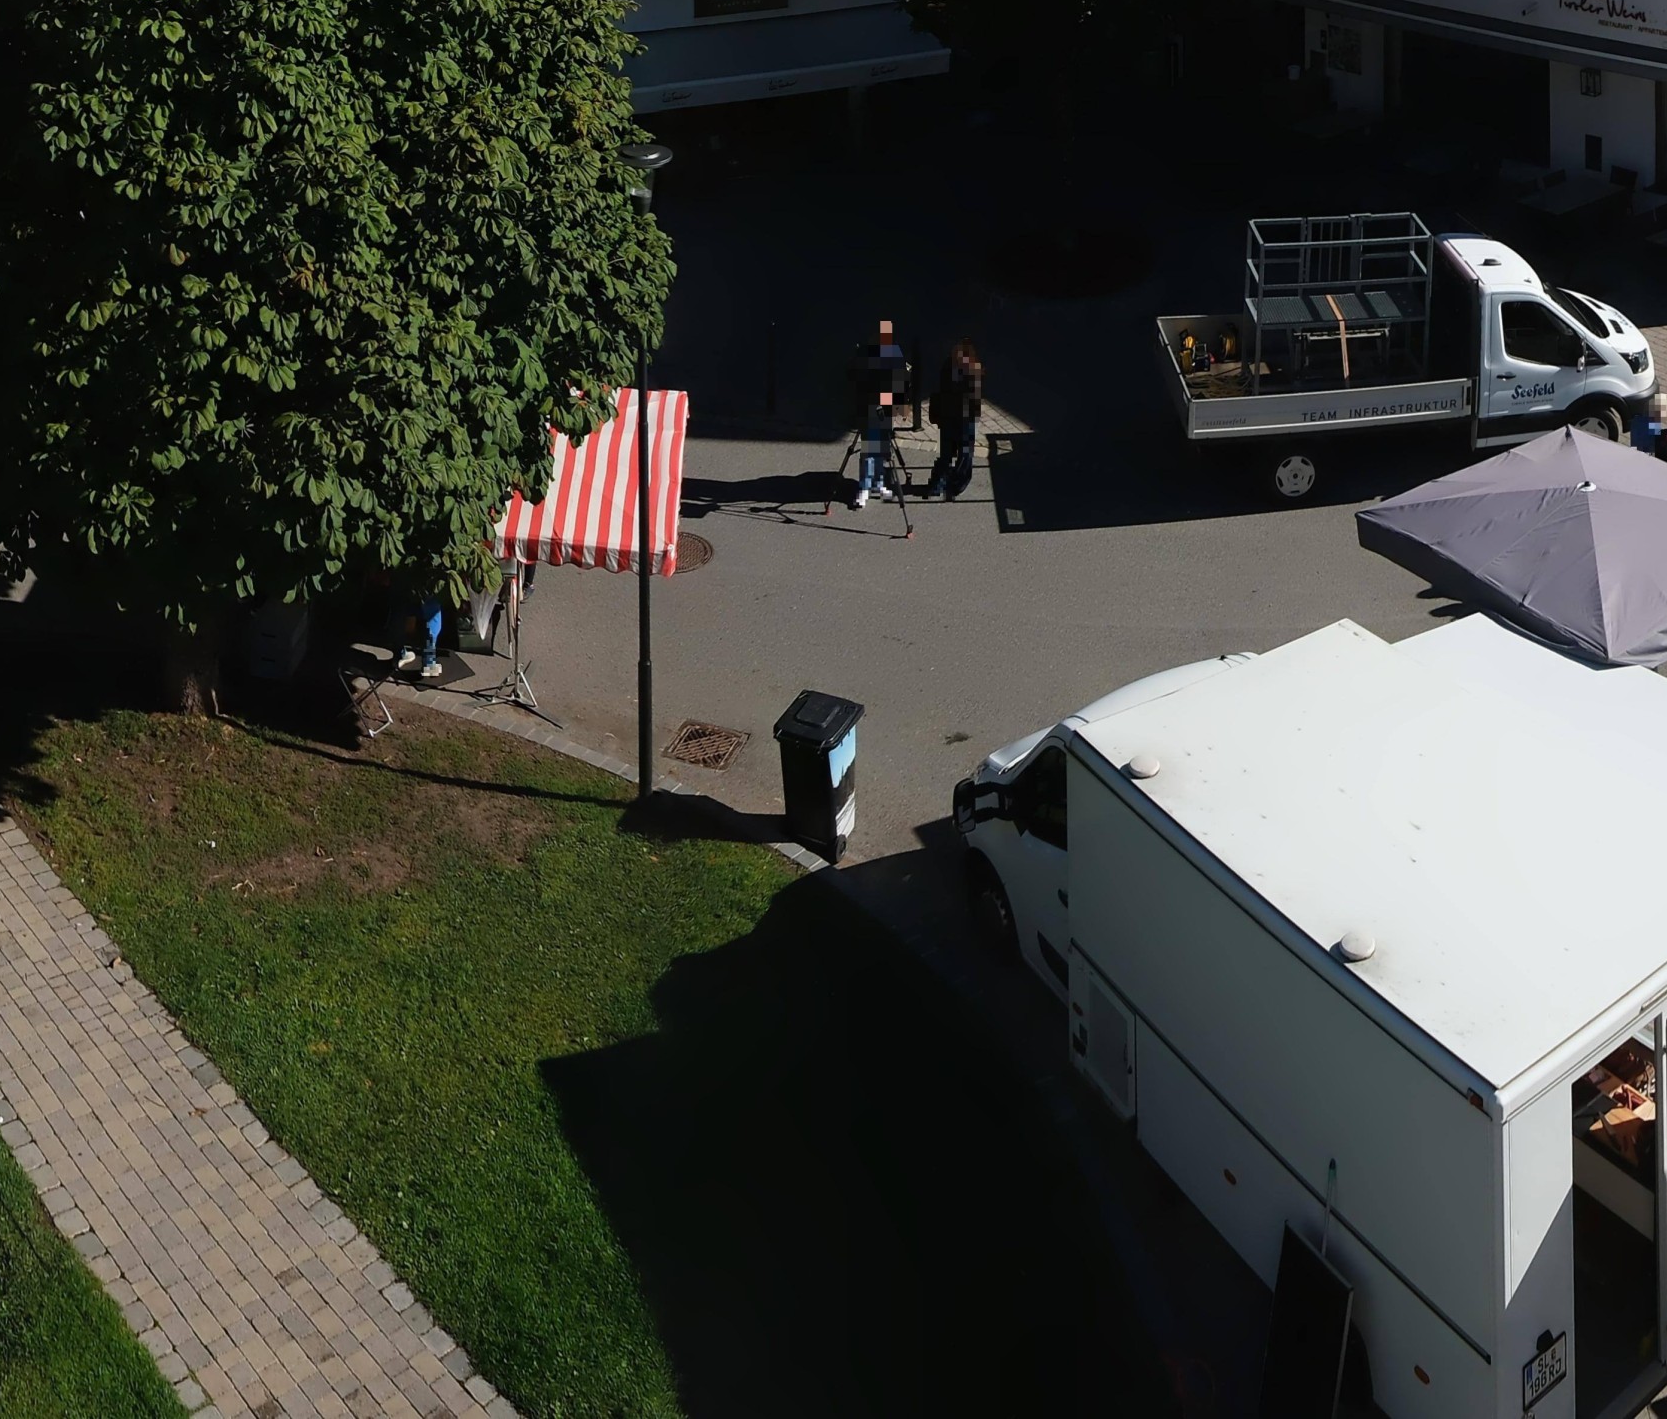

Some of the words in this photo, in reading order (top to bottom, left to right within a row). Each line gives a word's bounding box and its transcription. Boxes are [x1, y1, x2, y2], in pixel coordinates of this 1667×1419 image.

[1598, 20, 1632, 30] RESTAURANT
[1511, 382, 1556, 400] Seefeld
[1301, 411, 1337, 421] TEAM
[1349, 399, 1457, 419] INFRASTRUKTUR
[1538, 1354, 1549, 1374] SL
[1549, 1358, 1561, 1381] RJ
